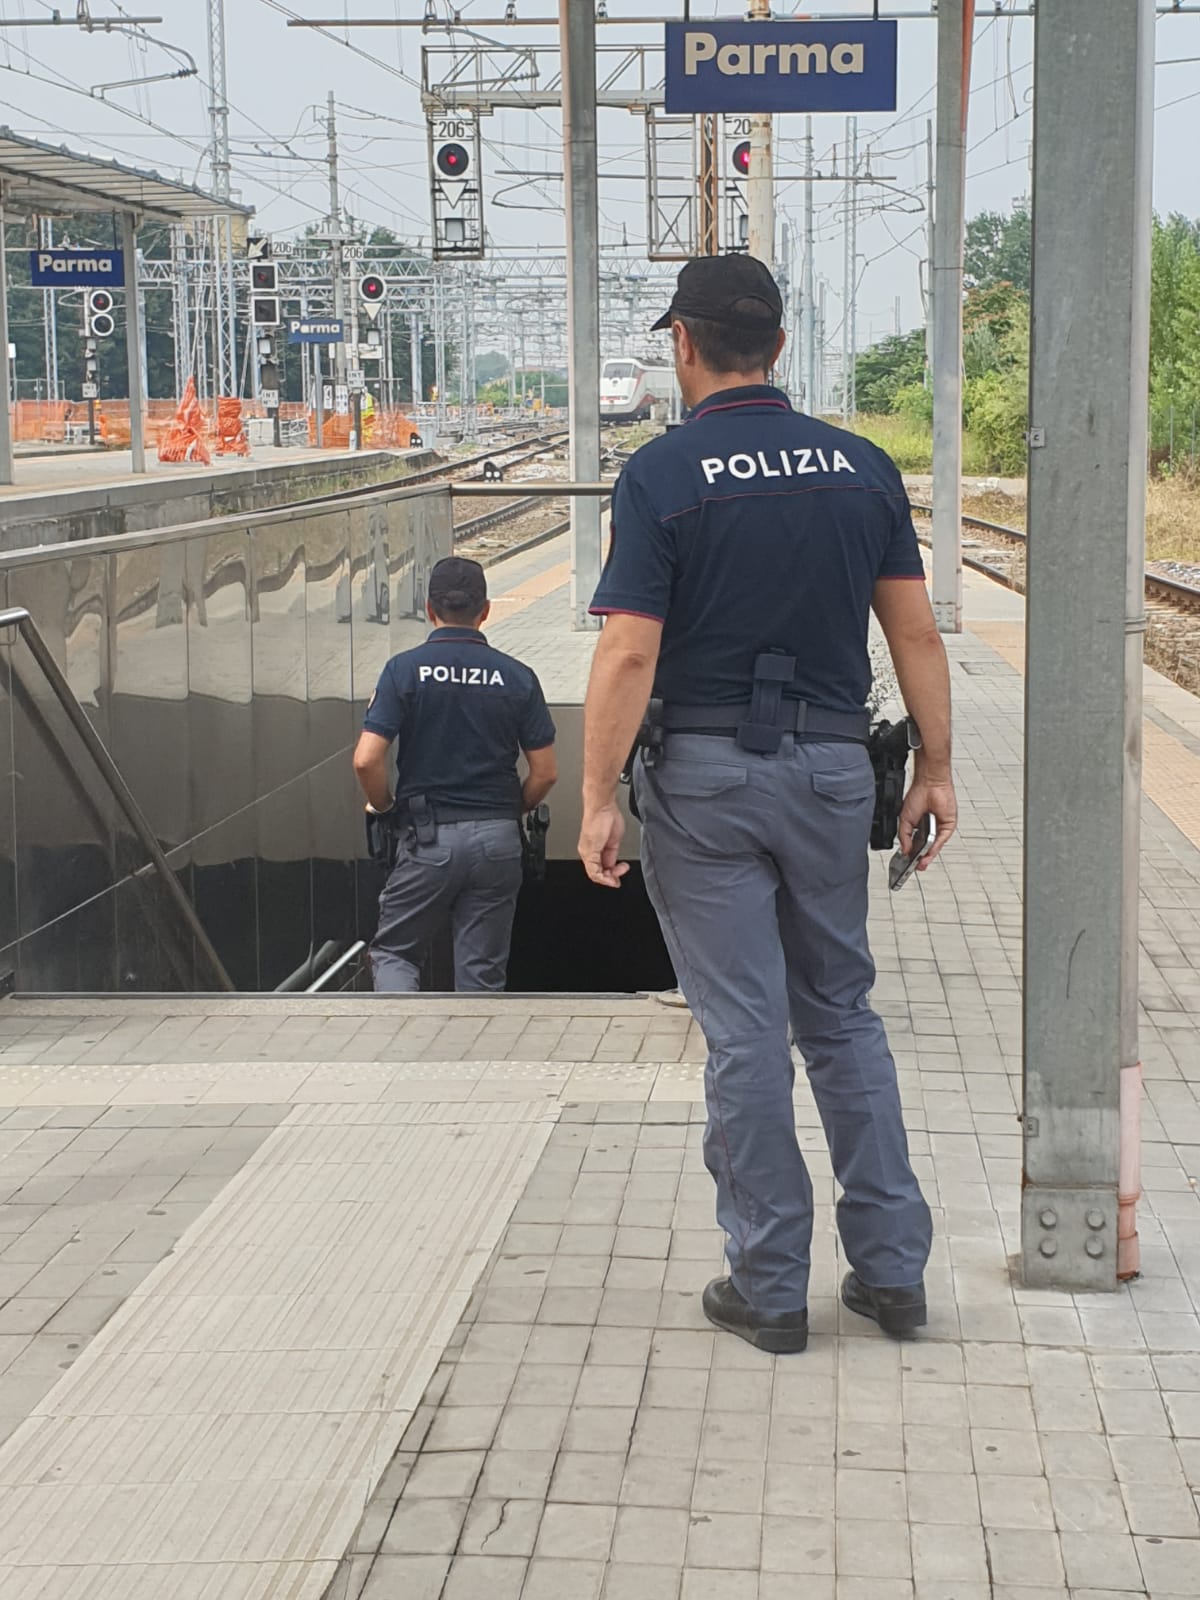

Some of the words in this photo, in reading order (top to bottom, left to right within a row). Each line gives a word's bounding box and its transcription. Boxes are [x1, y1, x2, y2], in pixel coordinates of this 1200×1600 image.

[684, 32, 864, 75] Parma
[439, 121, 465, 137] 206
[274, 241, 292, 254] 206
[344, 246, 363, 258] 206
[38, 254, 112, 272] Parma
[290, 321, 340, 333] Parma
[700, 448, 856, 484] POLIZIA
[419, 666, 504, 686] POLIZIA
